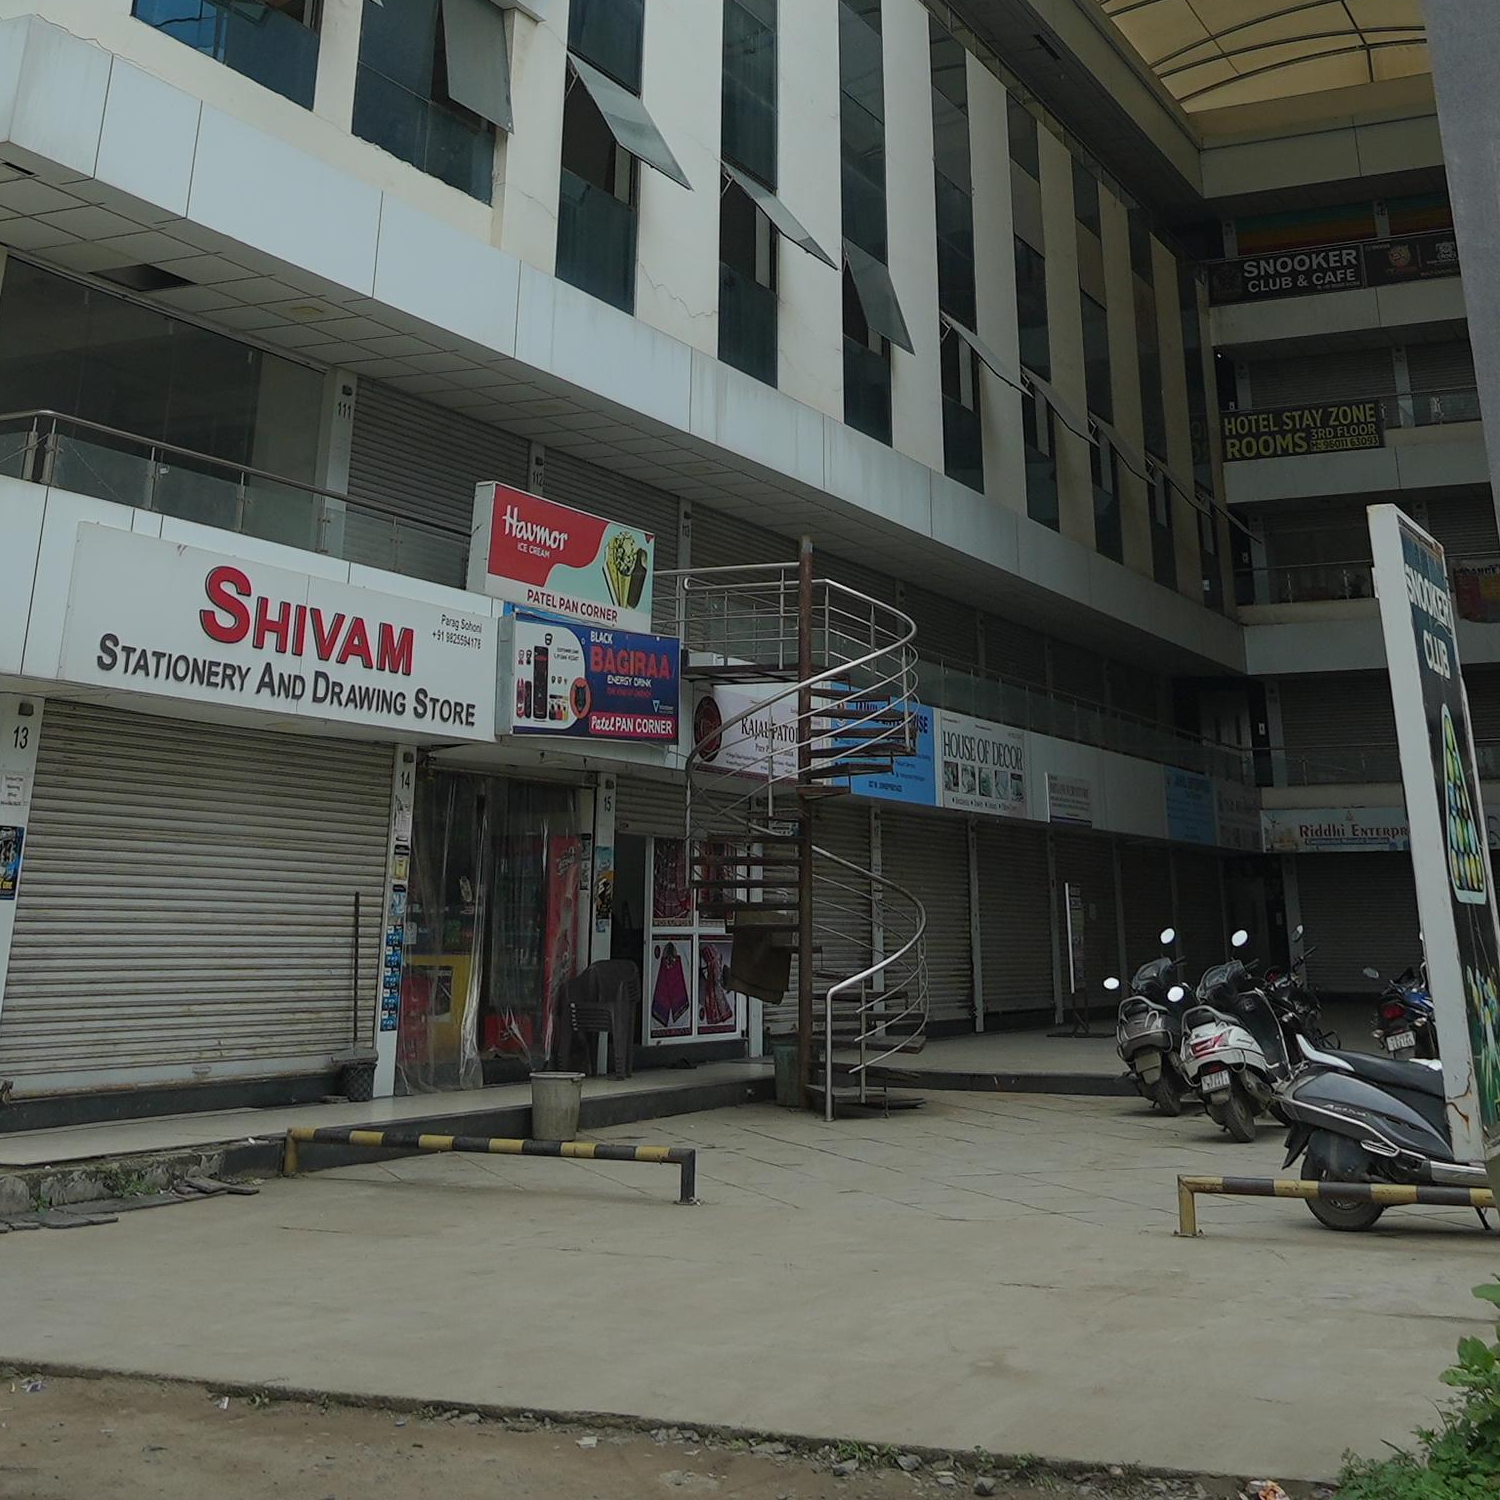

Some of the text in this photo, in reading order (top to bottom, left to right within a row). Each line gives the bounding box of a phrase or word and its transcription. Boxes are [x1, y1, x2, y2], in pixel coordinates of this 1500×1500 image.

[1243, 249, 1357, 278] SNOOKER
[1248, 277, 1293, 293] CLUB
[1297, 274, 1309, 287] &
[1312, 269, 1356, 285] CAFE
[338, 400, 352, 419] 111
[1224, 404, 1376, 436] HOTEL STAY ZONE
[1310, 423, 1376, 440] 3RD FLOOR
[1226, 433, 1308, 459] ROOMS
[502, 504, 568, 551] Havmor
[517, 542, 551, 559] ICE CREAM
[527, 588, 618, 623] PATEL PAN CORNER
[199, 565, 415, 677] SHIVAM
[590, 630, 613, 646] BLACK
[590, 645, 673, 681] BAGIRAA
[97, 633, 476, 728] STATIONERY AND DRAWING STORE
[607, 675, 633, 687] ENERGY
[591, 714, 673, 736] Patel PAN CORNER
[13, 726, 29, 750] 13
[942, 731, 1023, 771] HOUSE OF DECOR
[400, 771, 412, 789] 14
[604, 795, 612, 812] 15
[1299, 824, 1410, 839] Riddhi ENTERPR
